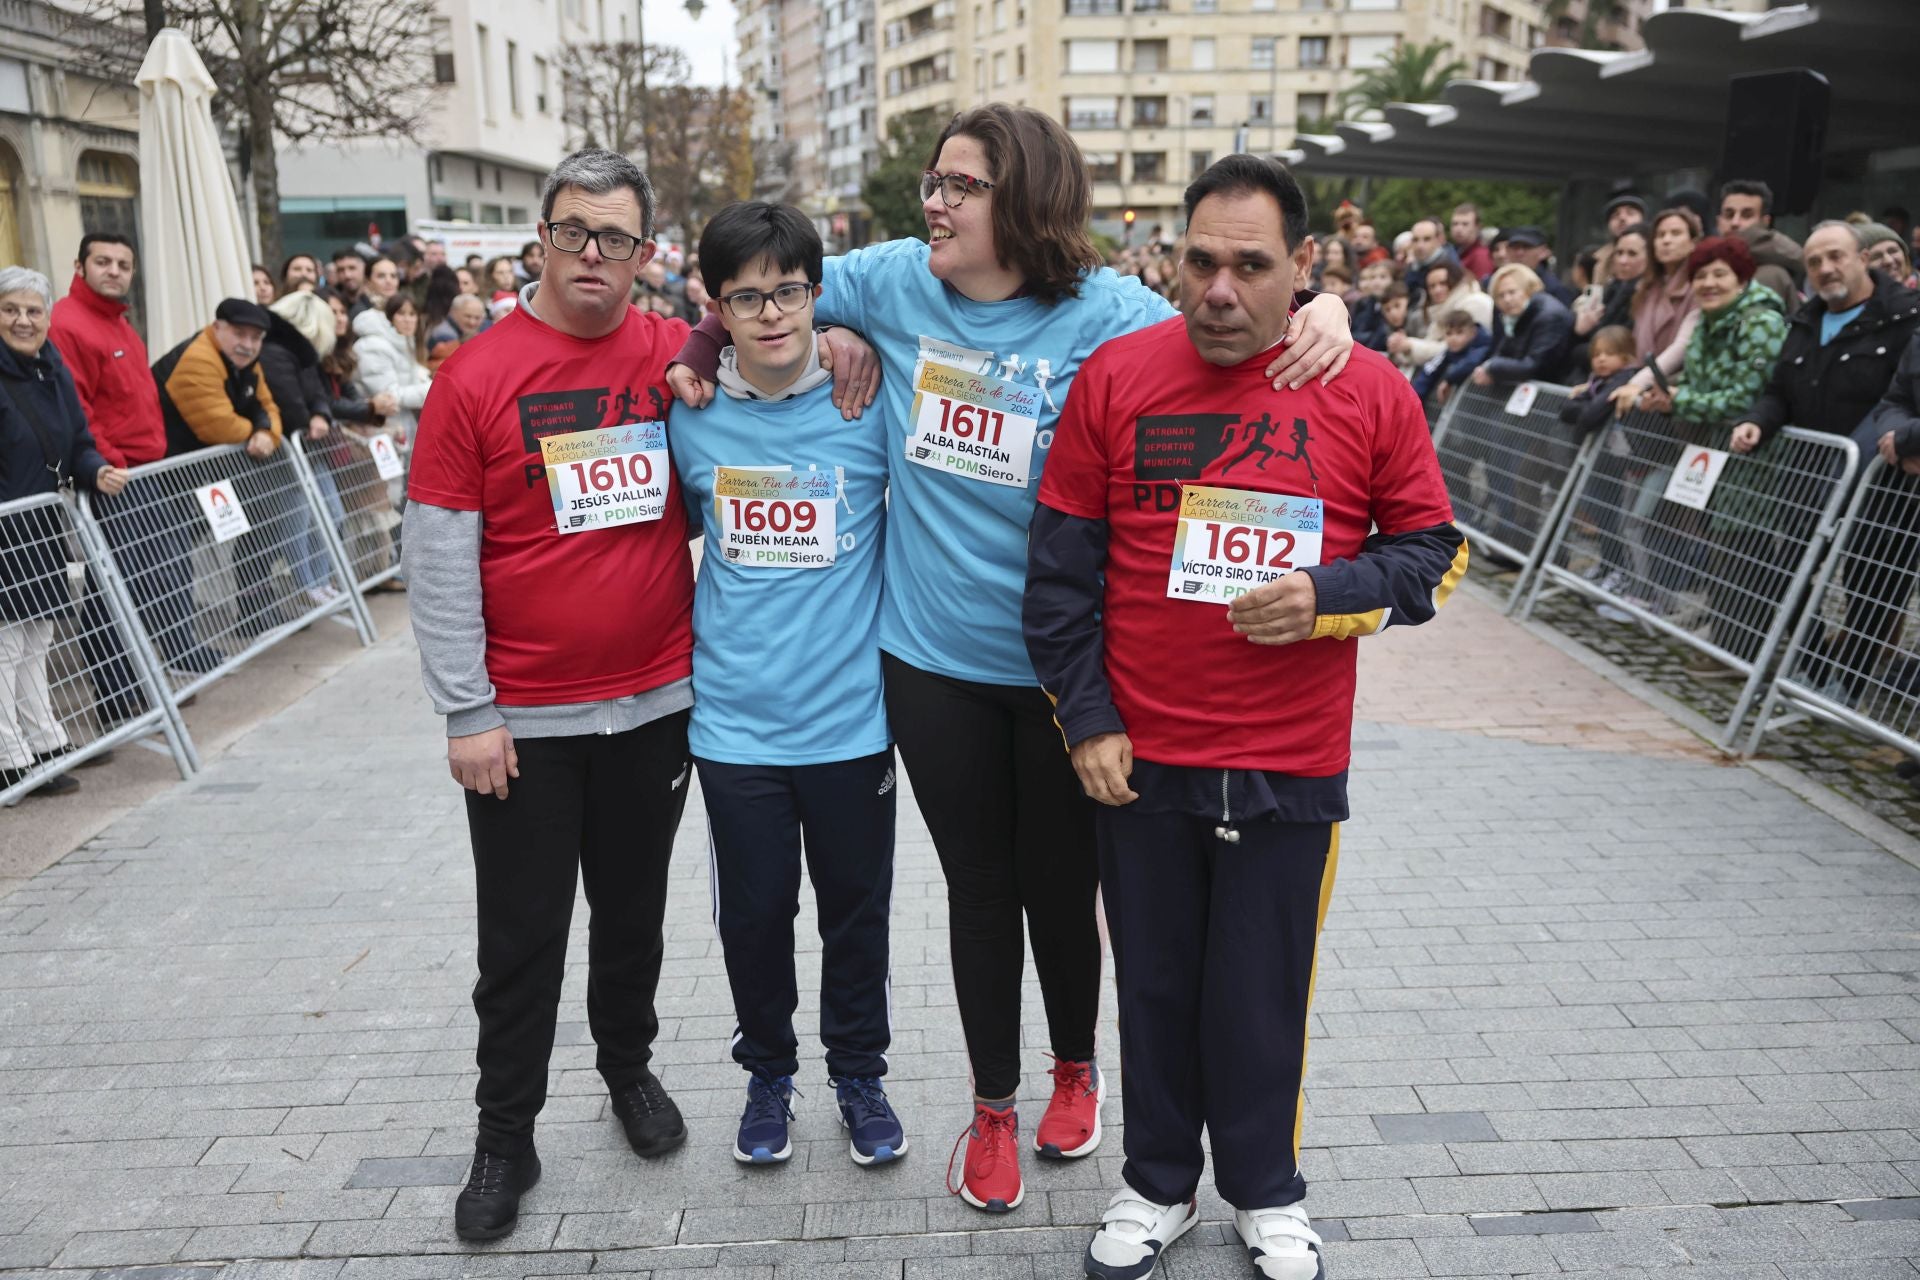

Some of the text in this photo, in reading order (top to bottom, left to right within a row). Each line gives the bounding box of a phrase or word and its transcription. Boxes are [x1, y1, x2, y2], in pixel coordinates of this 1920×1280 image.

[928, 348, 963, 362] PATRONATO
[922, 381, 982, 403] LA POLA SIERO
[924, 367, 1033, 404] Carrera Fin de Año
[529, 402, 574, 413] PATRONATO
[1011, 404, 1032, 415] 2024
[531, 415, 576, 426] DEPORTIVO
[940, 398, 1004, 446] 1611
[1145, 427, 1195, 436] PATRONATO
[547, 428, 661, 454] Carrera Fin de Año
[645, 440, 663, 449] 2024
[923, 433, 1009, 463] ALBA BASTIÁN
[1145, 442, 1194, 451] DEPORTIVO
[548, 445, 617, 463] LA POLA SIERO
[1144, 458, 1193, 467] MUNICIPAL
[571, 453, 652, 494] 1610
[946, 456, 1013, 480] PDMSiero
[719, 473, 829, 490] Carrera Fin de Año
[571, 487, 662, 510] JESÚS VALLINA
[1186, 493, 1240, 510] Carrera
[1245, 499, 1269, 513] Fin
[1272, 502, 1288, 516] de
[1290, 505, 1318, 519] Año
[730, 499, 816, 533] 1609
[1184, 508, 1263, 524] LA POLA SIERO
[1298, 520, 1319, 529] 2024
[731, 533, 818, 546] RUBÉN MEANA
[1206, 523, 1295, 569] 1612
[757, 550, 824, 563] PDMSiero
[1182, 560, 1222, 577] VÍCTOR
[1225, 567, 1253, 580] SIRO
